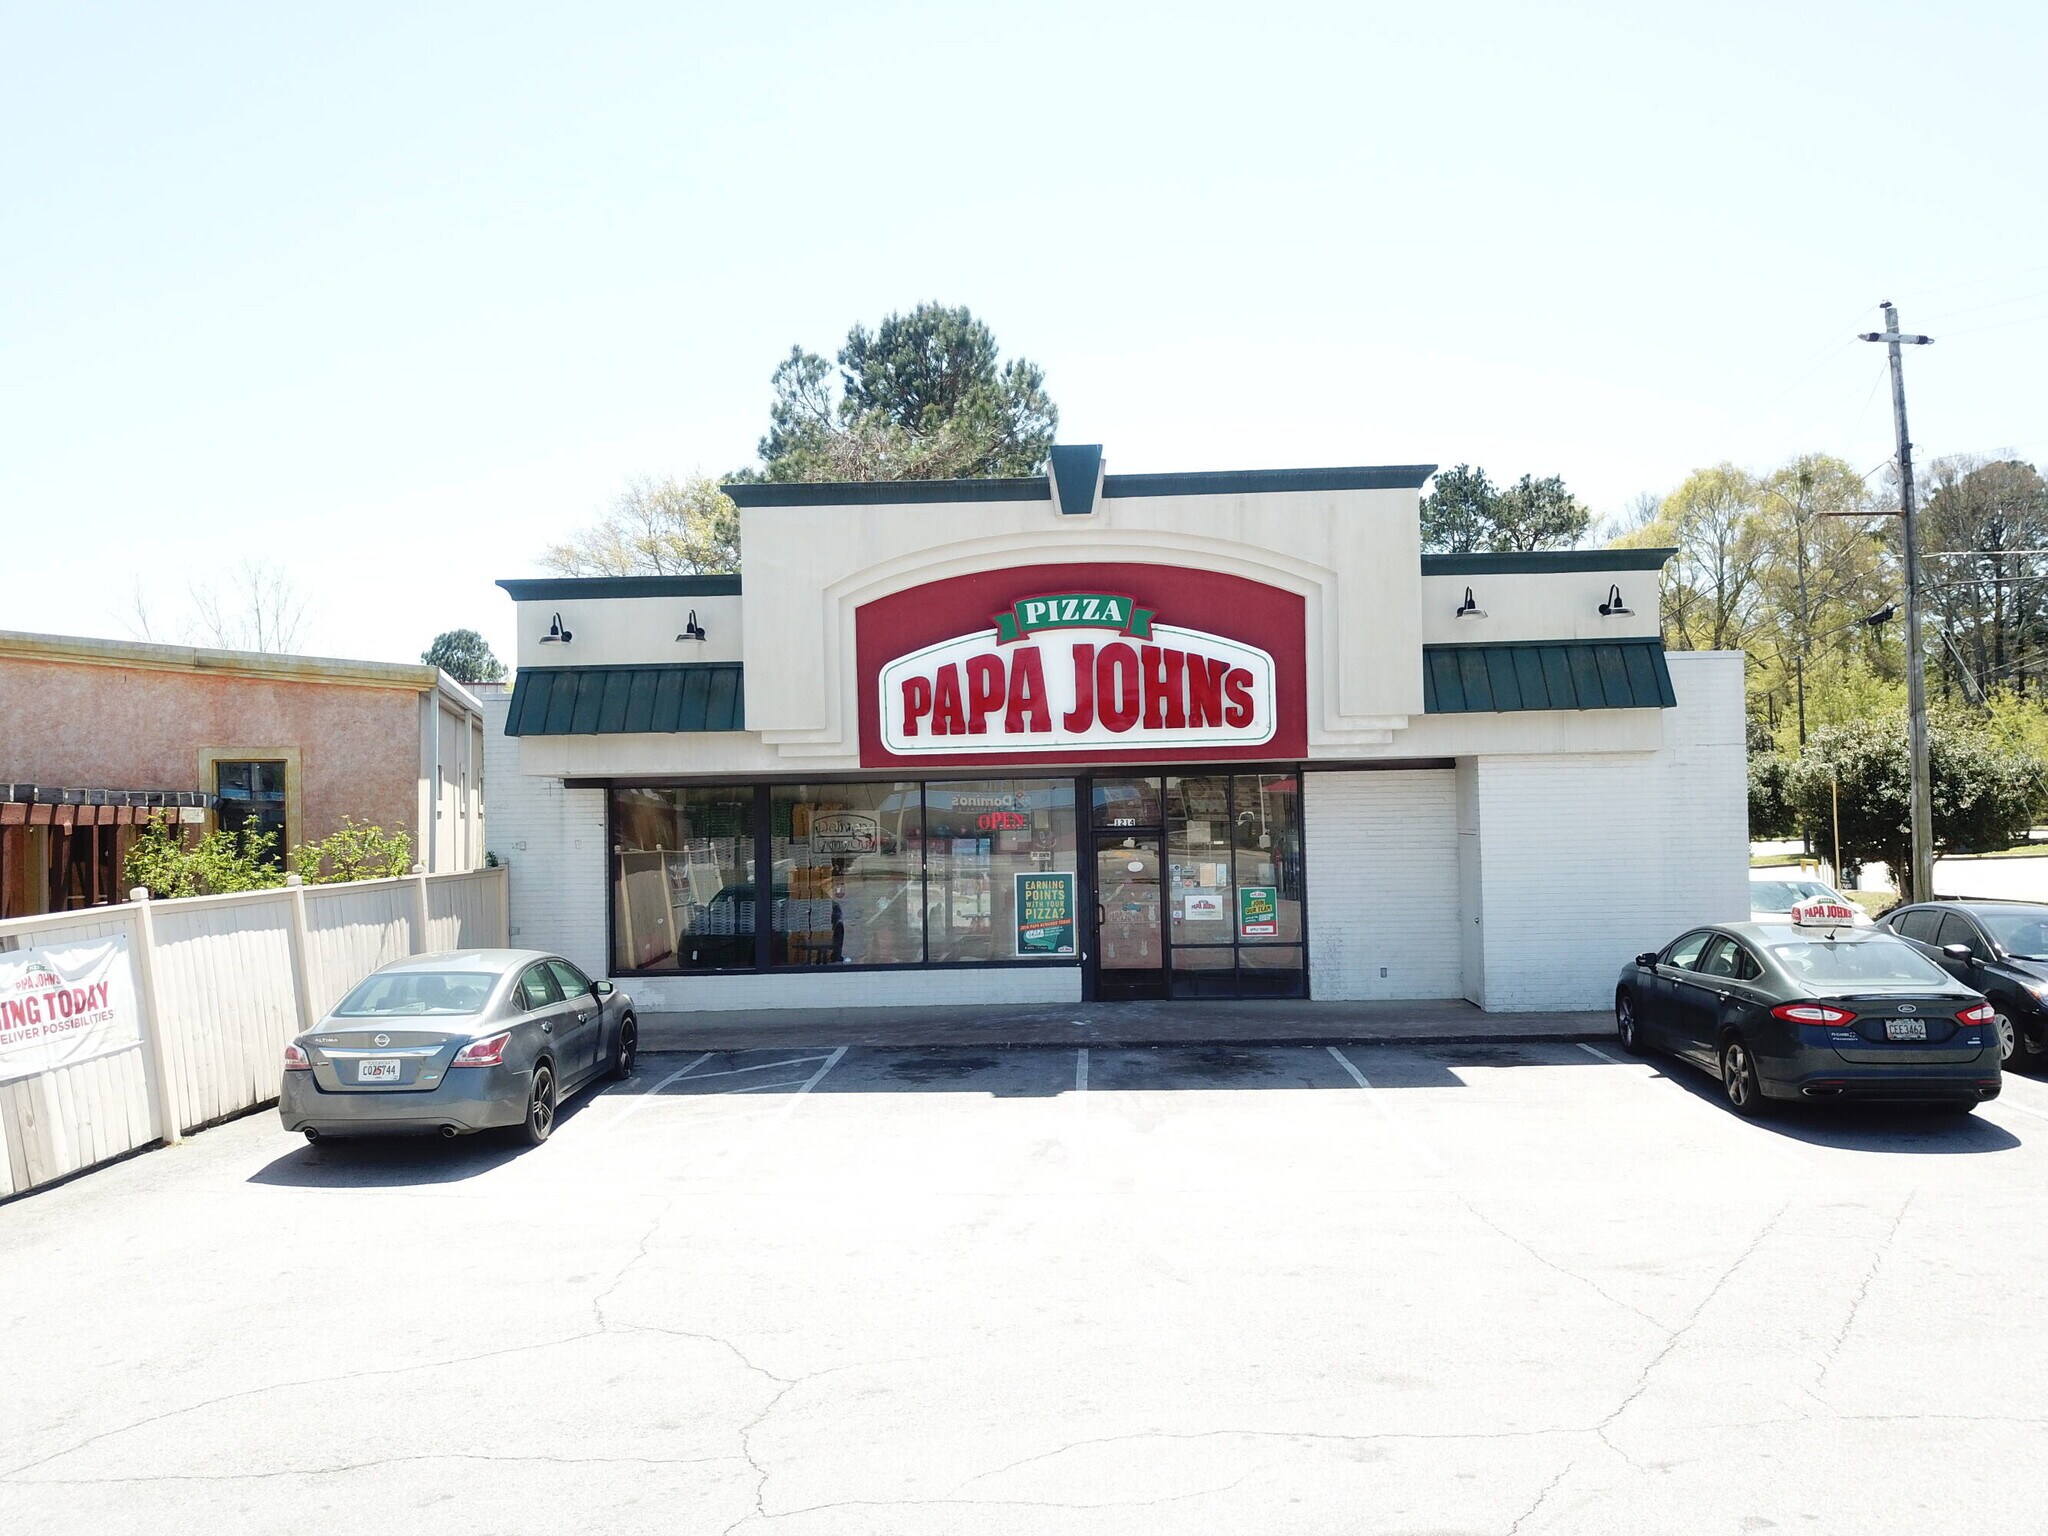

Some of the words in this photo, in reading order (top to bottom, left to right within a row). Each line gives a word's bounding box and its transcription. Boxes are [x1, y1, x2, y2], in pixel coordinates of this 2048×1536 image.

[1024, 598, 1123, 625] PIZZA
[902, 645, 1053, 737] PAPA
[977, 812, 1025, 830] OPEN
[1115, 819, 1134, 827] 1214
[1025, 880, 1065, 890] EARNING
[1025, 890, 1065, 900] POINTS
[1025, 909, 1066, 919] PIZZA?
[1804, 905, 1825, 917] PAPA
[0, 996, 41, 1031] ING
[43, 981, 108, 1020] TODAY
[0, 1027, 39, 1045] ELIVER
[43, 1010, 114, 1035] POSSIBILITIES
[1888, 1024, 1925, 1035] CEE3462
